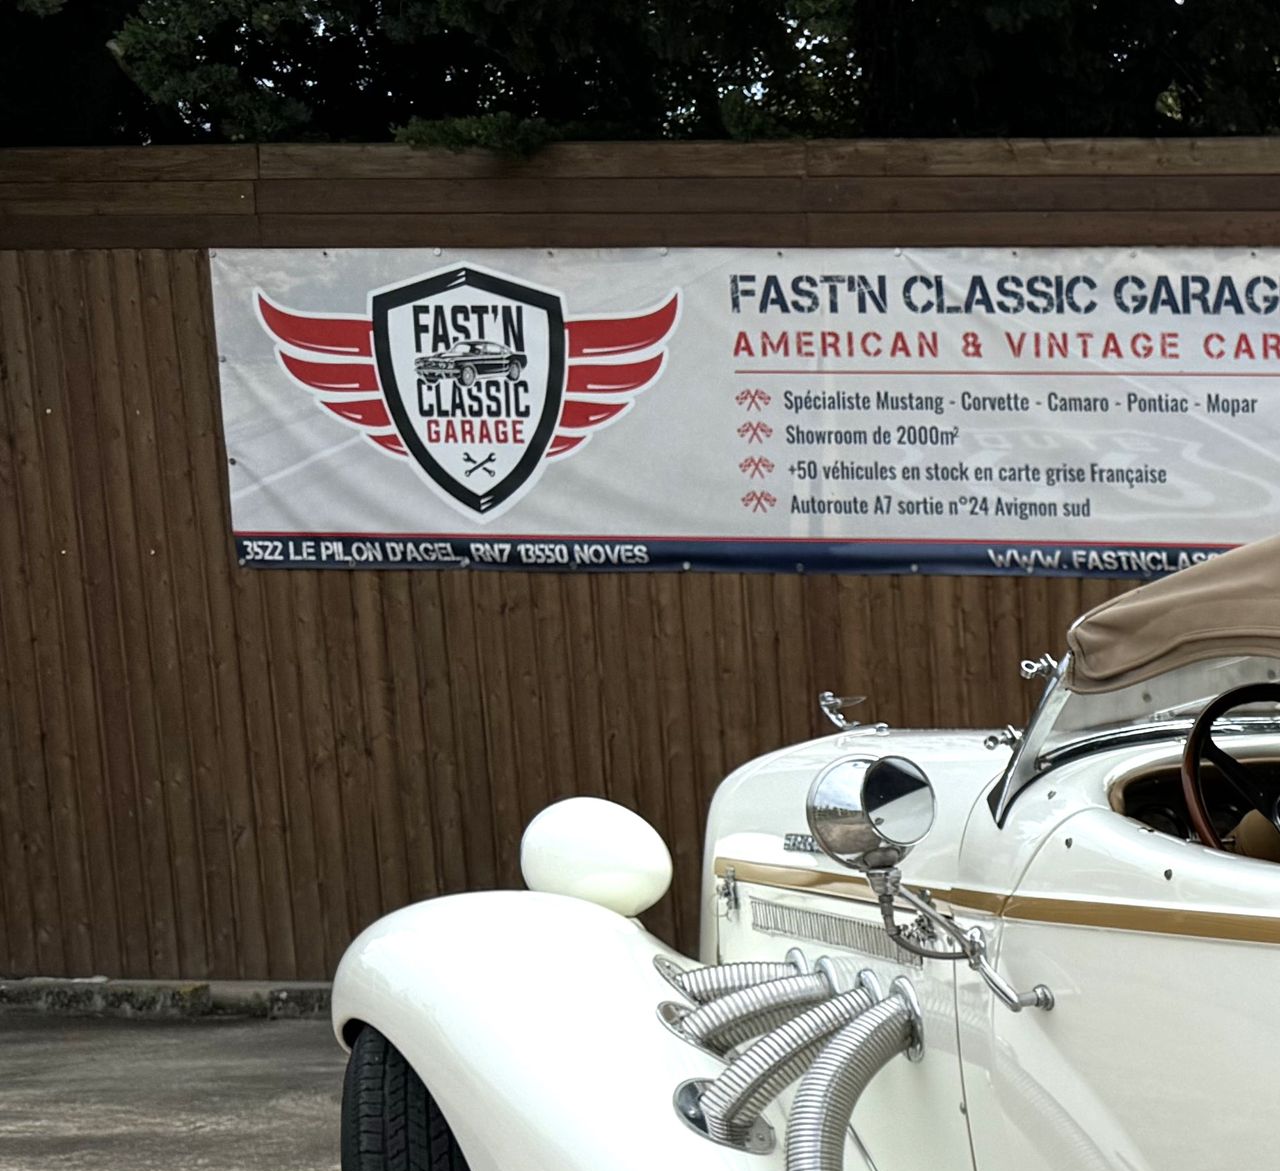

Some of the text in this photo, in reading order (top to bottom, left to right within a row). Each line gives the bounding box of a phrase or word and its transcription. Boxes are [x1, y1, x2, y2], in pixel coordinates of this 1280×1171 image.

[730, 275, 887, 314] FAST'N
[902, 275, 1098, 314] CLASSIC
[412, 305, 525, 353] FAST'N
[733, 331, 938, 358] AMERICAN
[961, 331, 982, 358] &
[1004, 331, 1180, 359] VINTAGE
[416, 378, 530, 418] CLASSIC
[783, 389, 871, 414] Spécialiste
[876, 391, 944, 415] Mustang
[961, 391, 1030, 412] Corvette
[1047, 392, 1109, 412] Camaro
[1127, 392, 1189, 413] Pontiac
[1206, 393, 1258, 417] Mopar
[427, 419, 525, 444] GARAGE
[785, 425, 959, 446] Showroom de 2000m²
[788, 460, 1167, 488] +50 véhicules en stock en carte grise Française
[790, 495, 1091, 520] Autoroute A7 sortie n°24 Avignon sud
[245, 541, 283, 561] 3522
[289, 541, 316, 561] LE
[321, 542, 383, 562] PILON
[470, 542, 511, 562] RN7
[517, 544, 568, 564] 13550
[575, 545, 649, 564] NOVES
